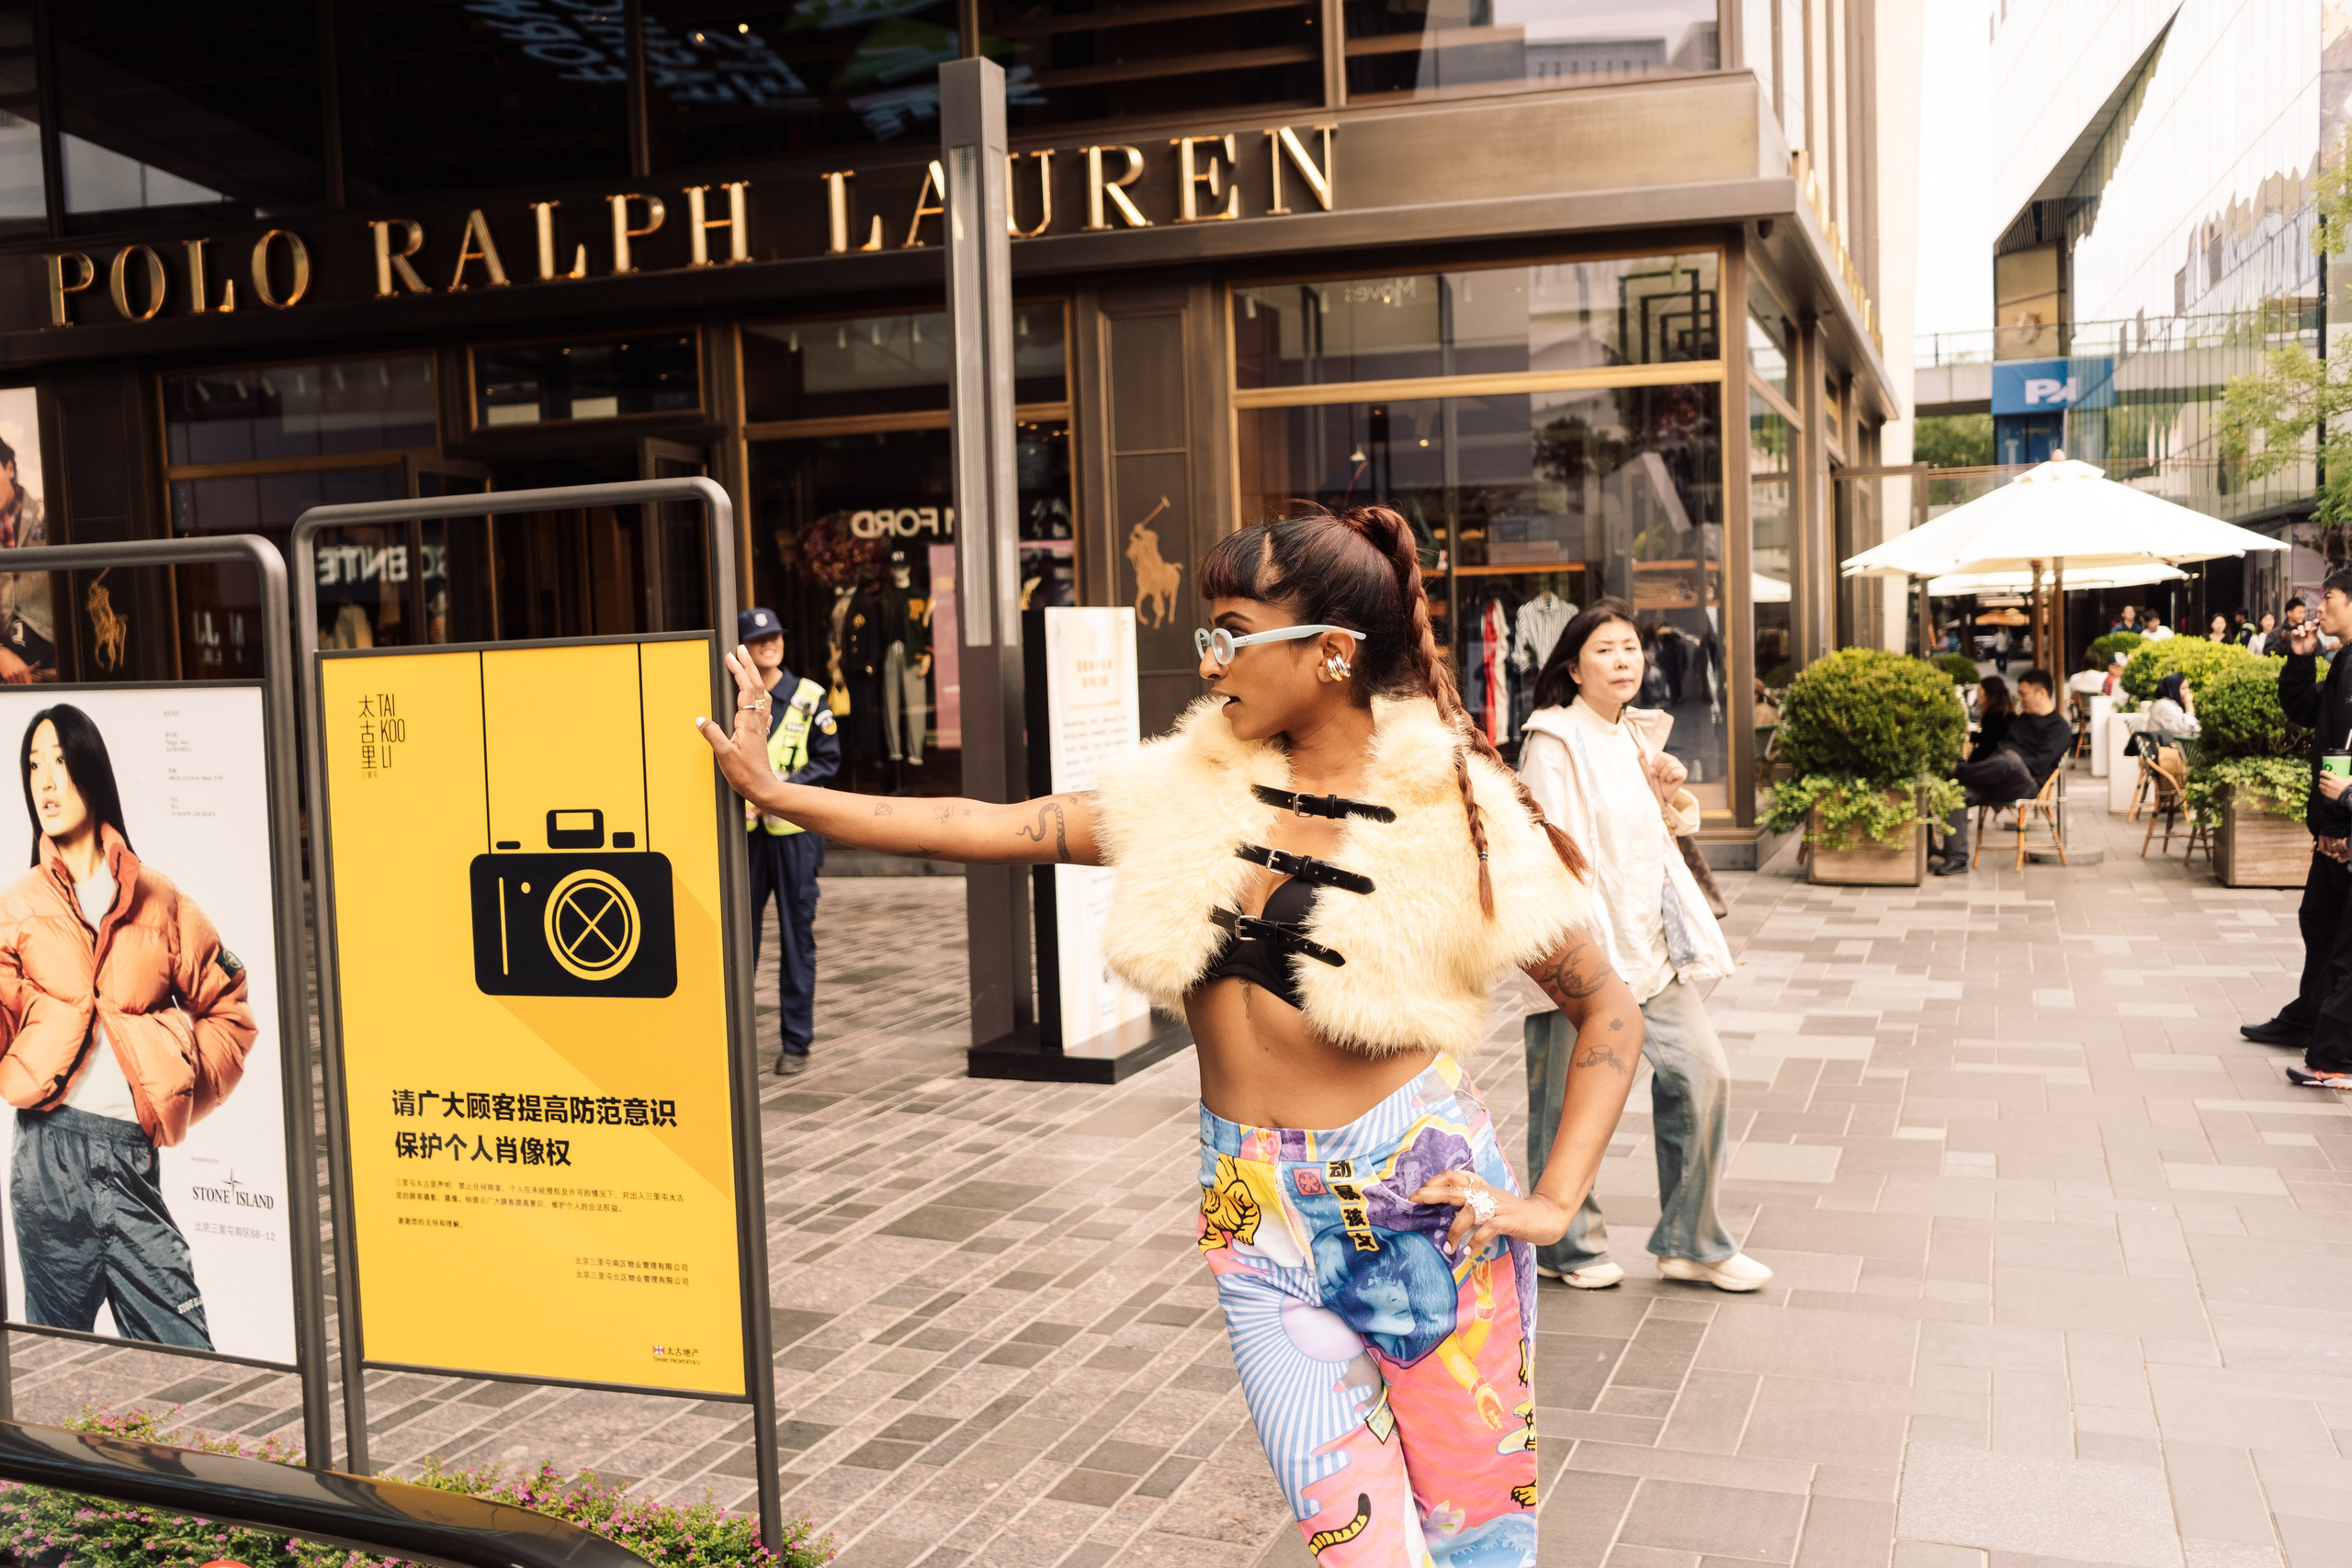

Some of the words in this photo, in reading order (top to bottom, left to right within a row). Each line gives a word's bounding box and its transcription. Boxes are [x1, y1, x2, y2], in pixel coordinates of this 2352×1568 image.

[41, 229, 312, 331] POLO
[368, 179, 755, 299] RALPH
[377, 694, 395, 717] TAI
[358, 694, 378, 769] 太古里
[380, 718, 406, 742] KOO
[381, 745, 392, 768] LI
[392, 1089, 677, 1127] 请广大顾客提高防范意识
[395, 1131, 571, 1167] 保护个人肖像权
[192, 1186, 231, 1204] STONE
[236, 1191, 274, 1210] ISLAND
[575, 1257, 688, 1272] 北京三里屯南区物业管理有限公司
[576, 1270, 689, 1286] 北京三里屯北区物业管理有限公司
